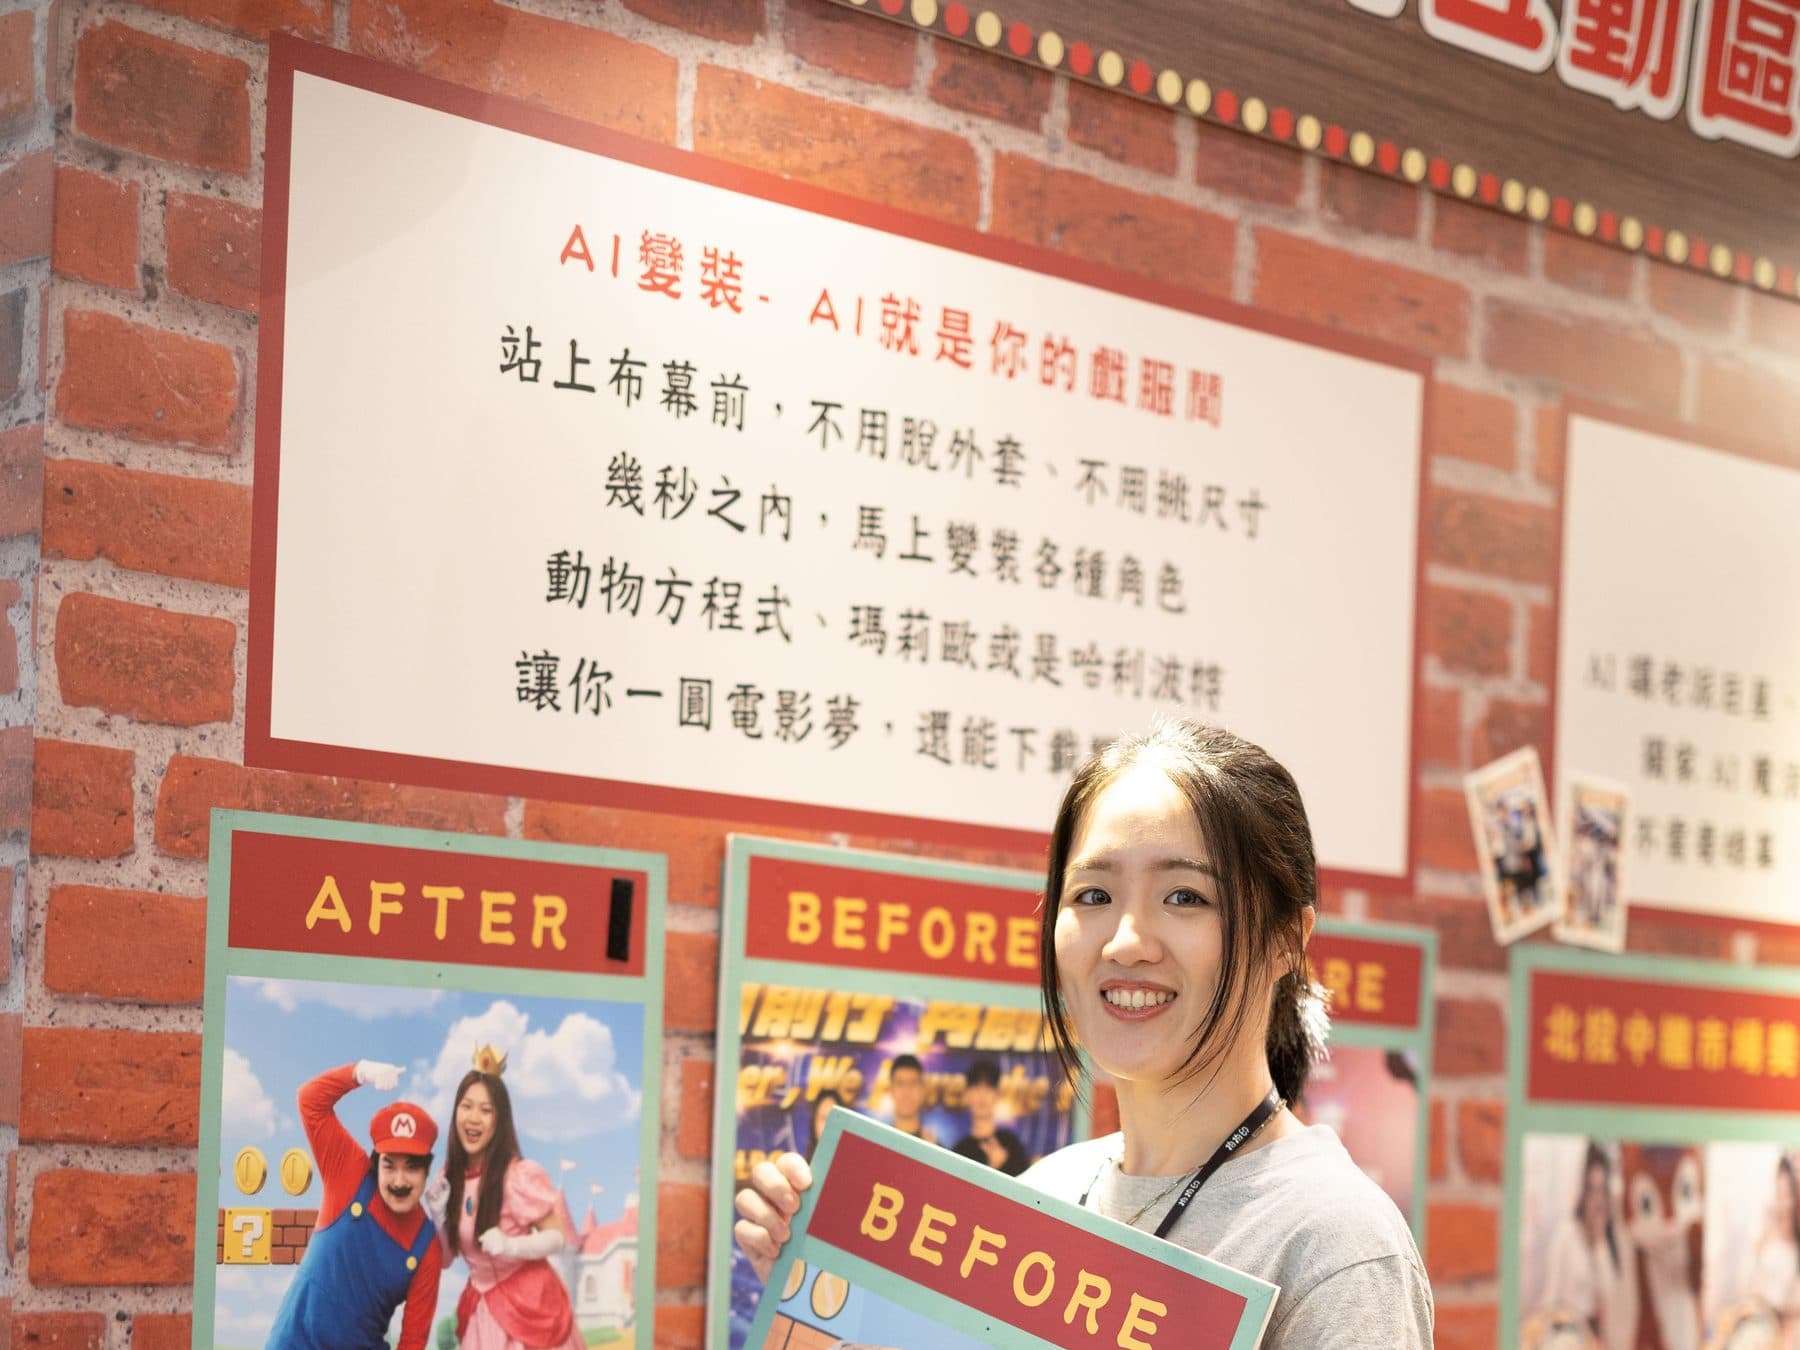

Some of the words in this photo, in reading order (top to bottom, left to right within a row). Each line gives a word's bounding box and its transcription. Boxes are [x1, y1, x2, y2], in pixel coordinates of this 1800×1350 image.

[559, 223, 771, 315] AI變裝-
[515, 649, 1120, 775] 讓你一圓電影夢，還能下載
[305, 874, 568, 951] AFTER
[786, 890, 1041, 969] BEFORE
